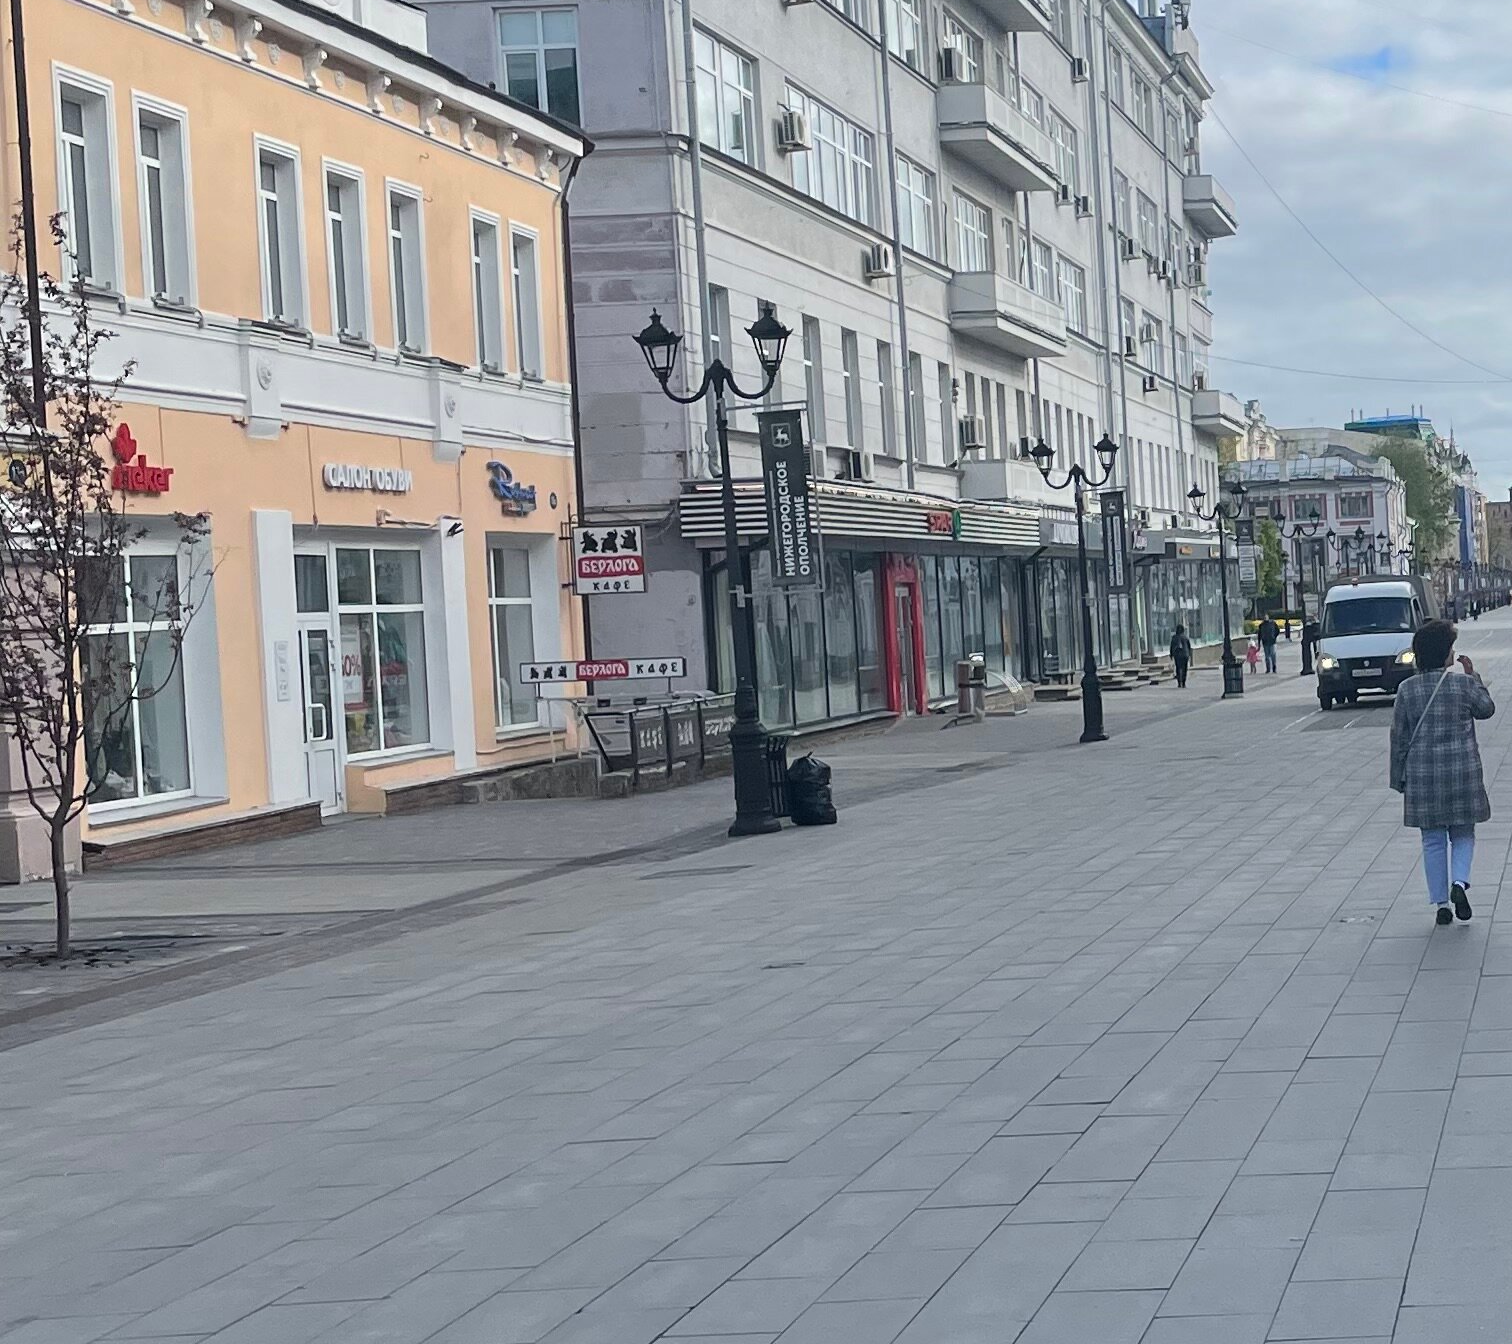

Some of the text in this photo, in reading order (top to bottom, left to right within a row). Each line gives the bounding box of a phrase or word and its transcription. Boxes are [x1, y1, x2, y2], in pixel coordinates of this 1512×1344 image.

[323, 463, 412, 493] САЛОН ОБУВИ
[776, 460, 796, 576] НИЖЕГОРОДСКОЕ
[794, 495, 810, 575] ОПОЛЧЕНИЕ
[581, 558, 639, 575] БЕРЛОГА
[593, 580, 630, 592] КАФЕ
[579, 661, 678, 677] БЕРЛОГА КАФЕ
